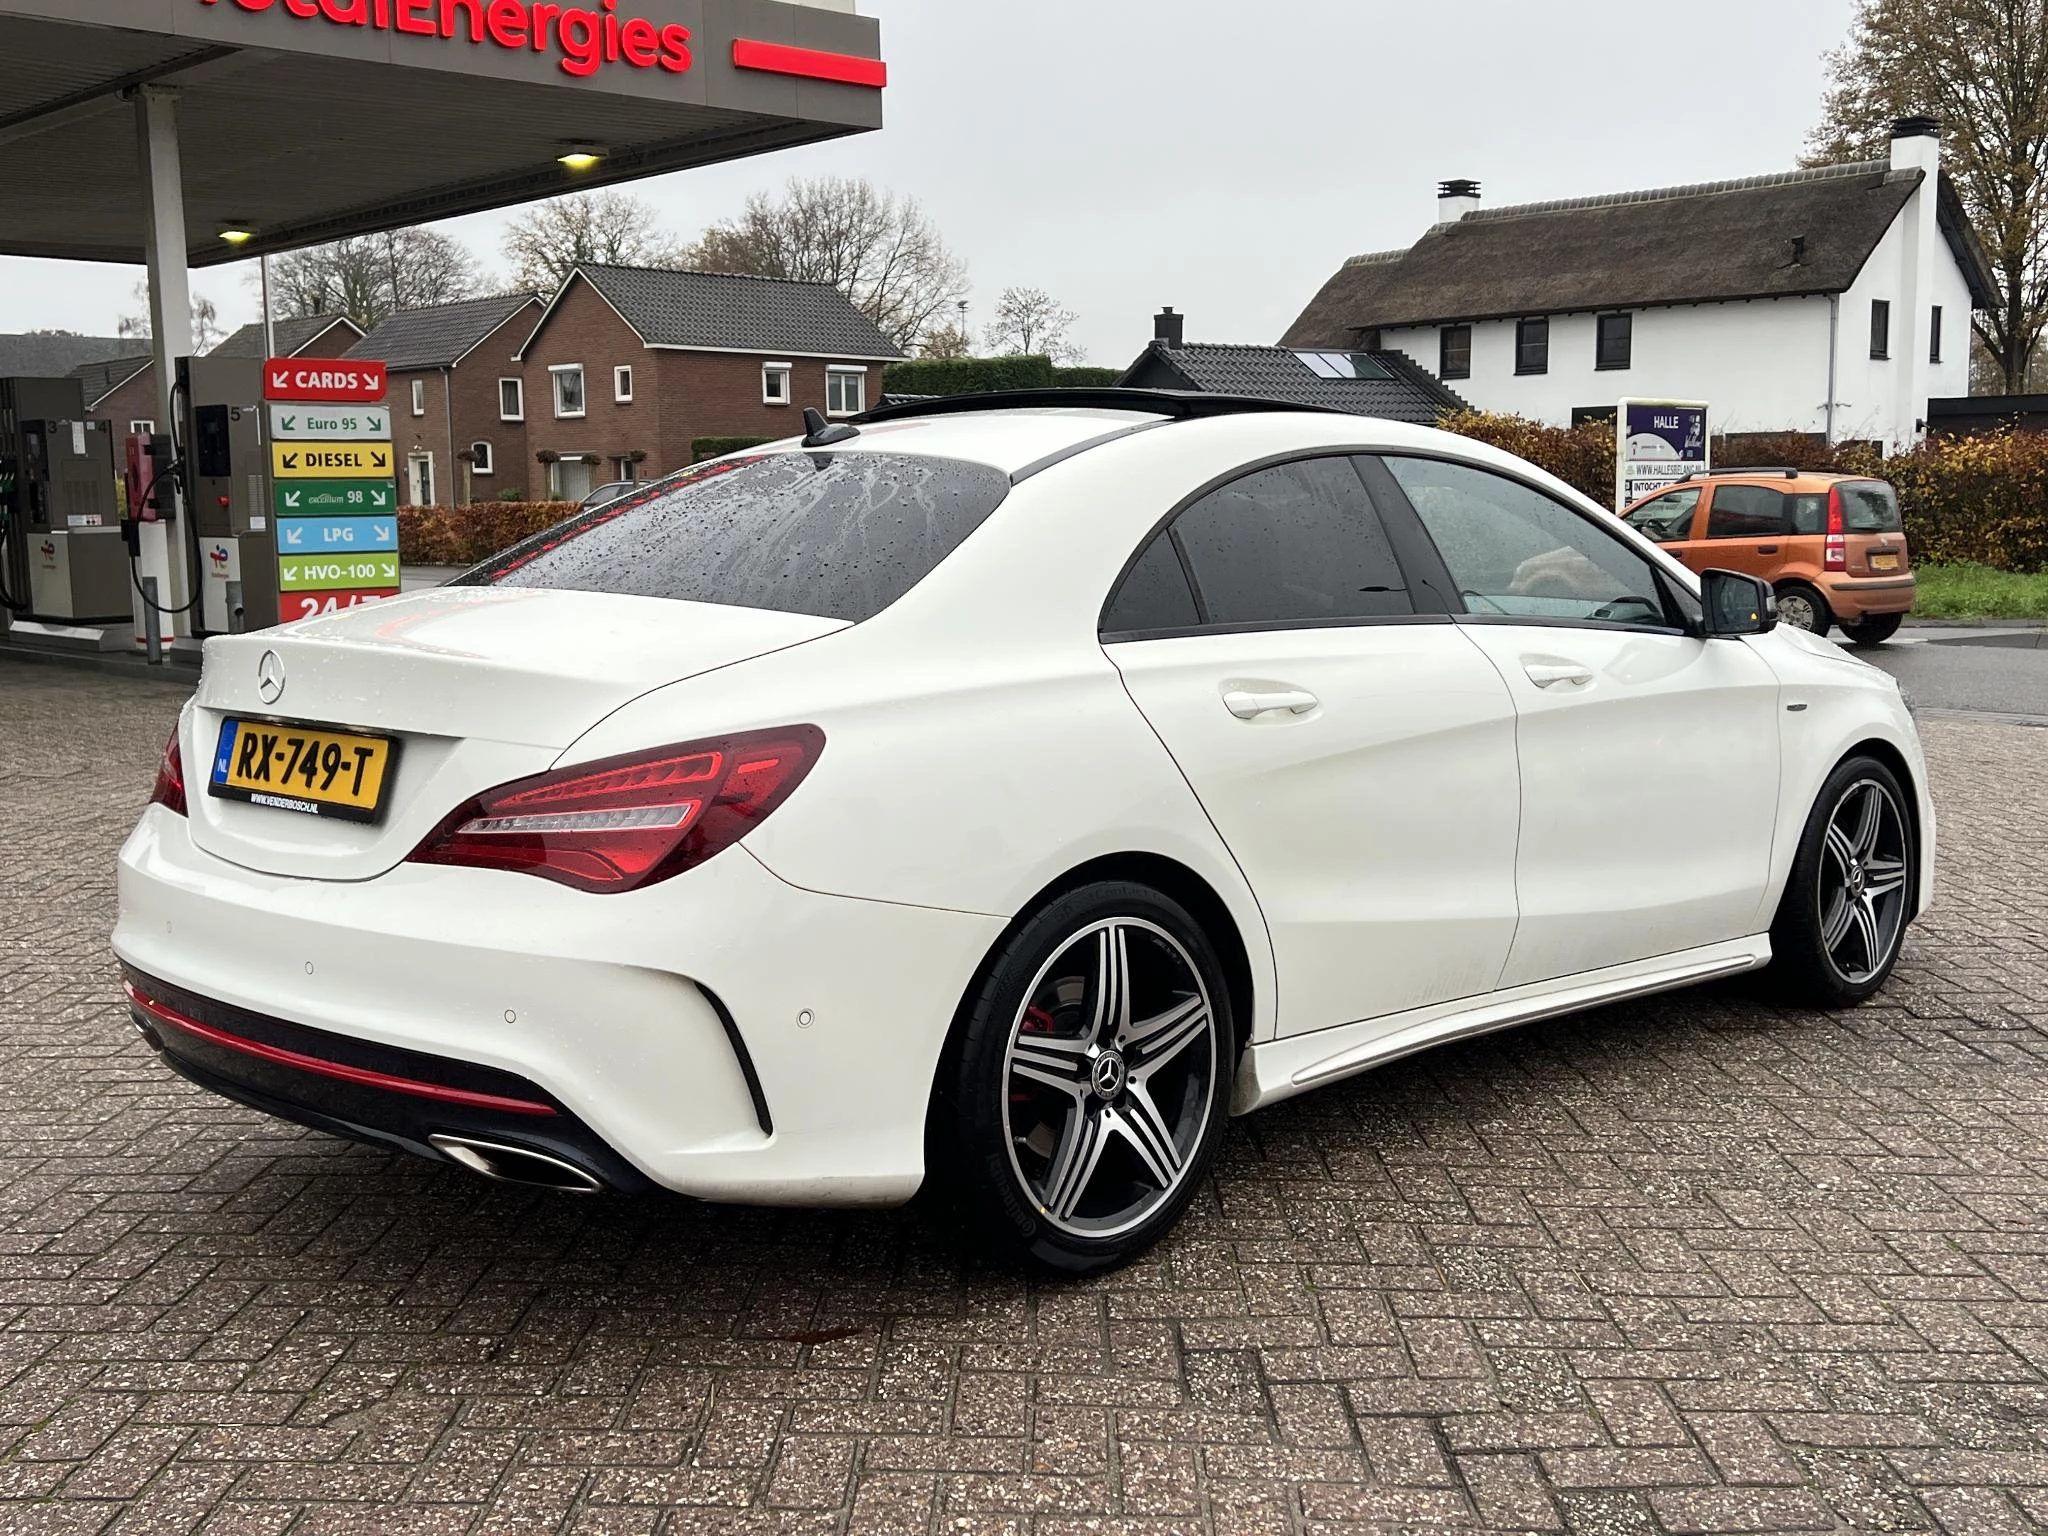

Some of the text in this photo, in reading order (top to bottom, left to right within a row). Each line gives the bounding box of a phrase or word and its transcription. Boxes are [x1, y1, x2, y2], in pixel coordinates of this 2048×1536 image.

[200, 0, 693, 77] aEnergies
[295, 372, 358, 390] CARDS
[230, 408, 241, 422] 5
[1653, 415, 1679, 429] HALLE
[306, 417, 358, 431] Euro 95
[305, 453, 363, 467] DIESEL
[1633, 482, 1661, 492] INTOCHT
[346, 490, 364, 504] 98
[323, 528, 354, 543] LPG
[304, 564, 376, 580] HVO-100
[300, 595, 381, 619] 24
[217, 758, 228, 773] NL
[236, 732, 374, 797] RX-749-T
